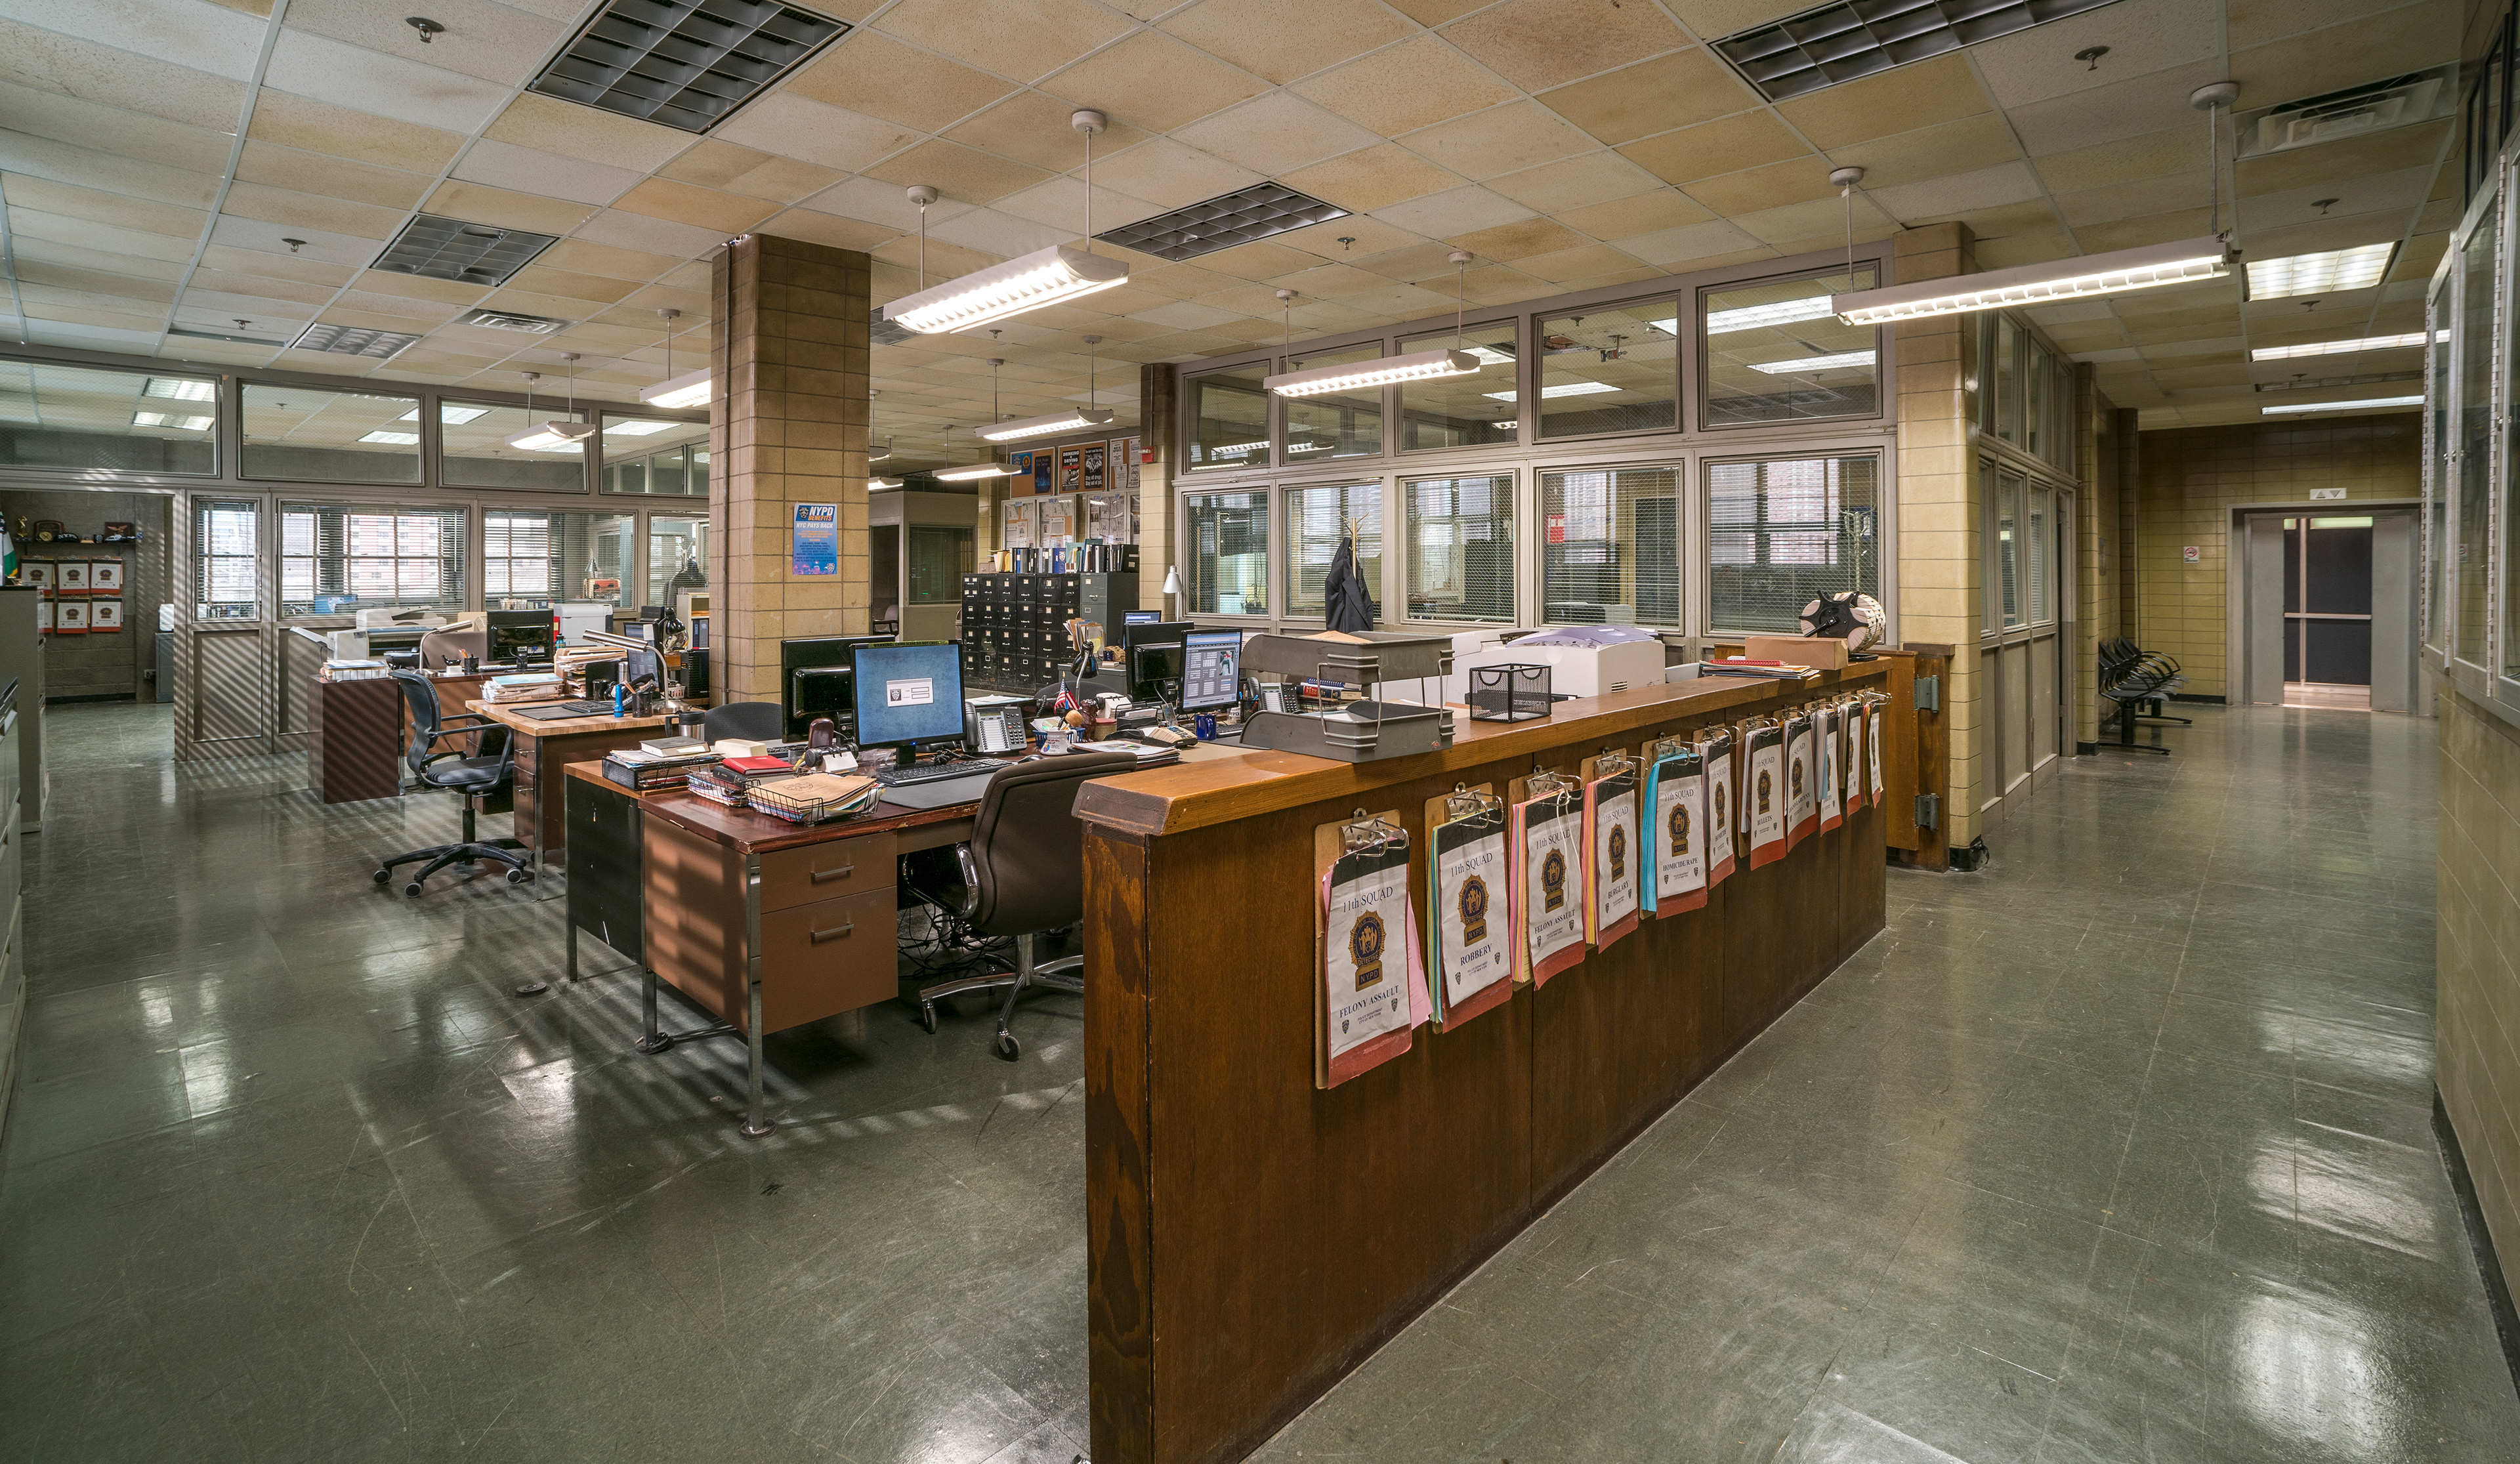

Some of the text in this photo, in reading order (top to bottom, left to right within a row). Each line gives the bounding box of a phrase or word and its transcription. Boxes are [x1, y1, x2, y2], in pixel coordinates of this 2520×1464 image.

[809, 506, 833, 516] NYPD
[1761, 756, 1775, 766] SQUAD
[1665, 789, 1694, 801] 11th SQUAD
[1612, 806, 1629, 820] SQUAD
[1757, 815, 1773, 826] BULLETS
[1536, 838, 1547, 849] 11th
[1451, 852, 1493, 877] 11th SQUAD
[1608, 880, 1629, 899] BURGLARY
[1343, 887, 1393, 913] 11th SQUAD
[1534, 909, 1575, 934] FELONY ASSAULT
[1357, 954, 1379, 966] DETECTIVE
[1460, 943, 1492, 966] ROBBERY
[1339, 985, 1399, 1018] FELONY ASSAULT
[1366, 1008, 1383, 1017] DEPARTMENT
